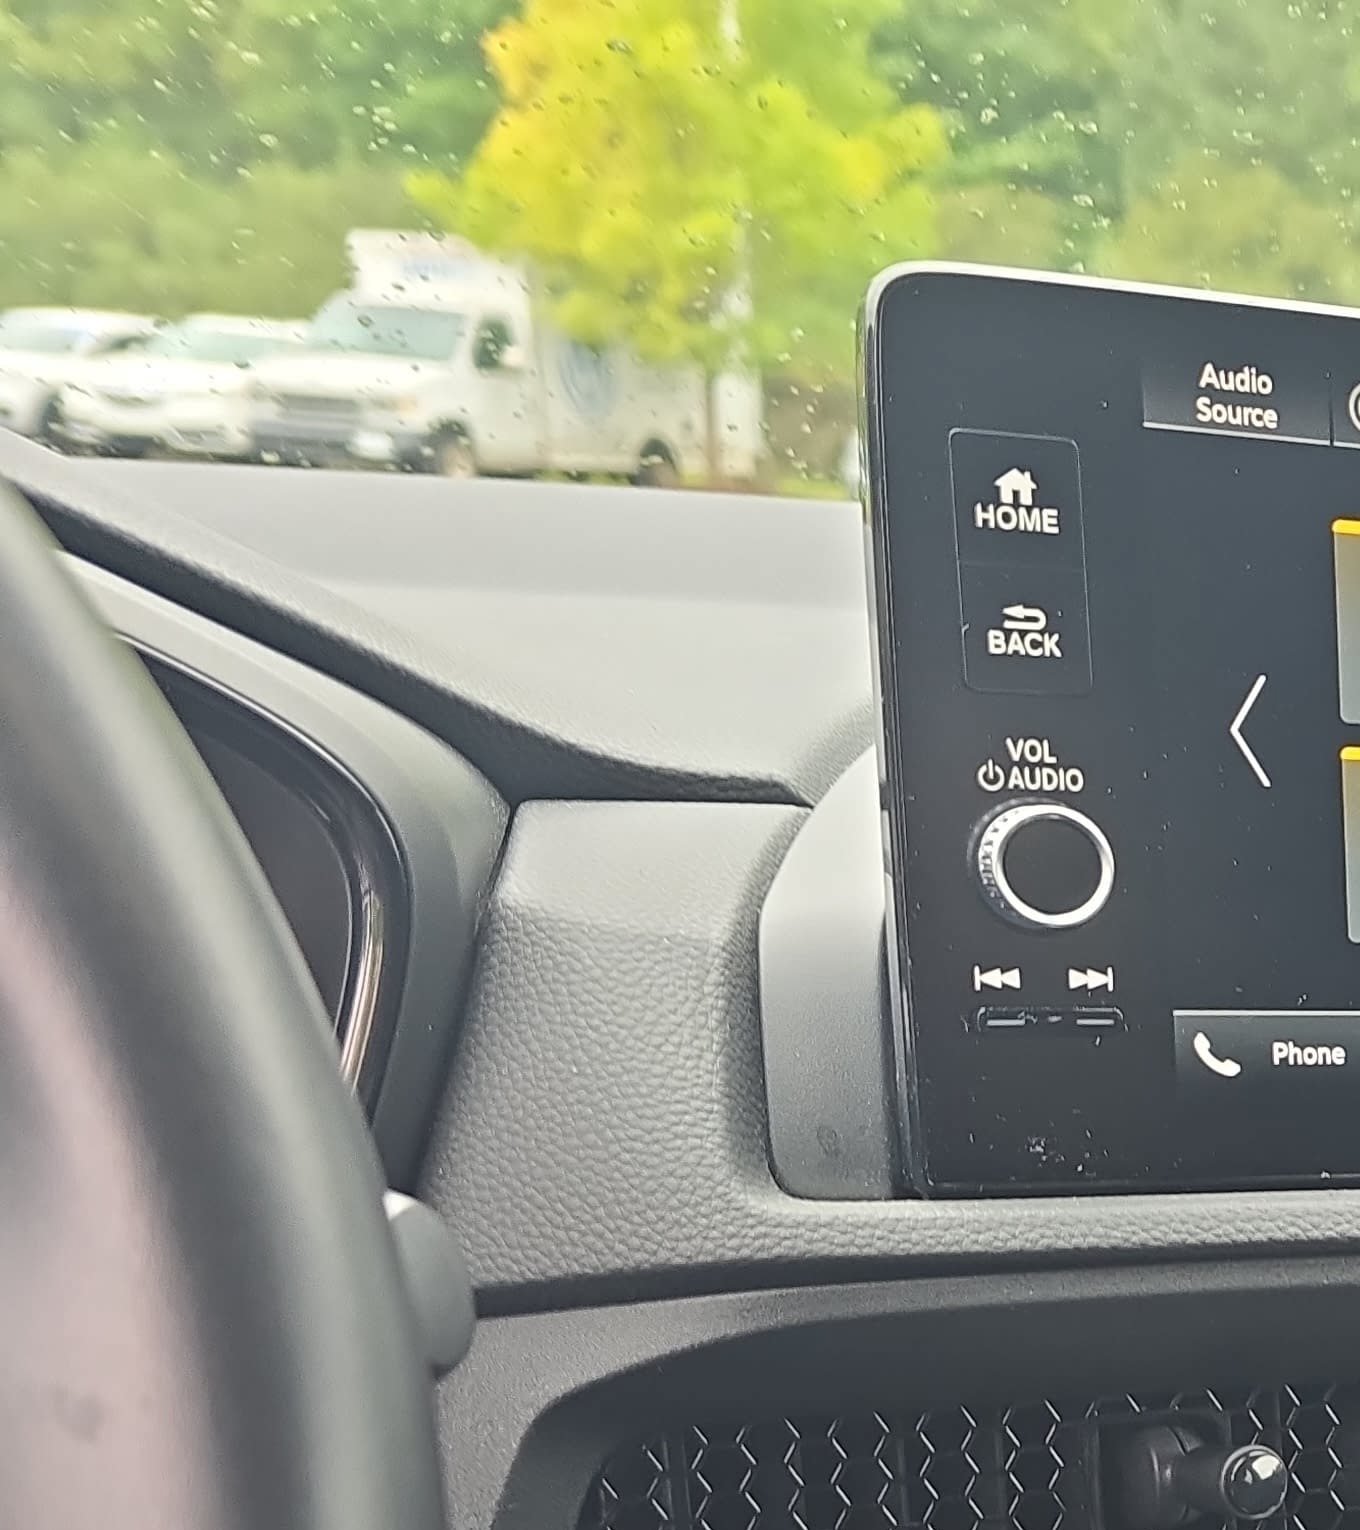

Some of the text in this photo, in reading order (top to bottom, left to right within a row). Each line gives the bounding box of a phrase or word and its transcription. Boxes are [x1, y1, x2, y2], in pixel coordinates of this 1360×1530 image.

[1199, 362, 1273, 396] Audio
[1196, 396, 1279, 429] Source
[974, 502, 1060, 534] HOME
[988, 630, 1062, 658] BACK
[1006, 738, 1057, 764] VOL
[1007, 766, 1084, 793] AUDIO
[1272, 1042, 1346, 1066] Phone
